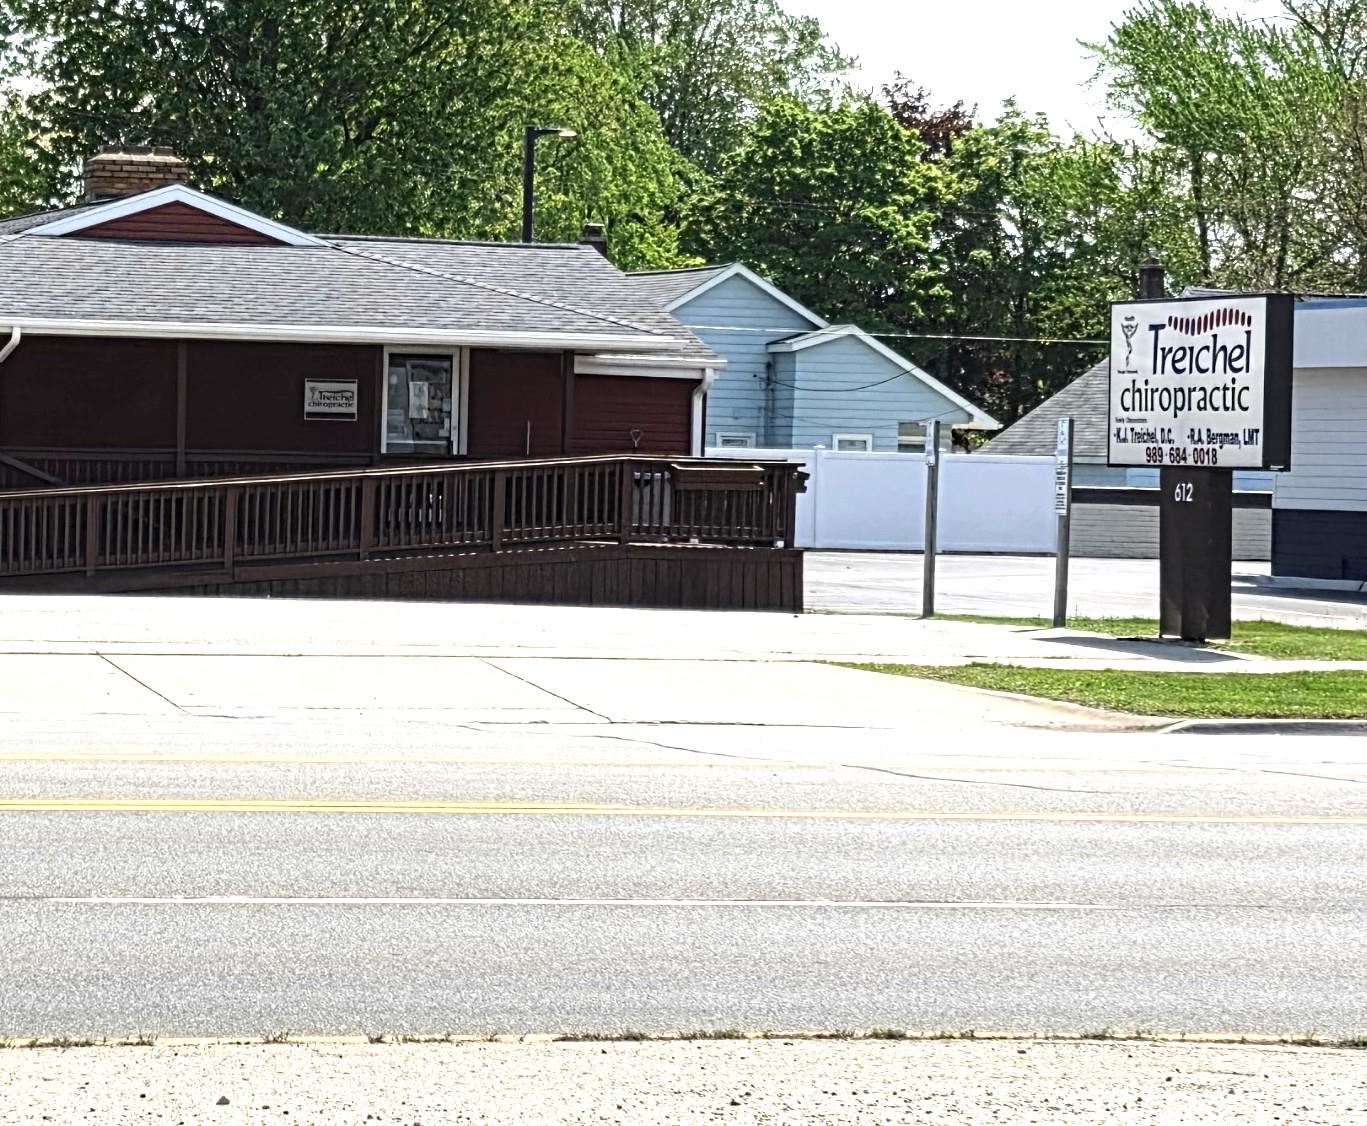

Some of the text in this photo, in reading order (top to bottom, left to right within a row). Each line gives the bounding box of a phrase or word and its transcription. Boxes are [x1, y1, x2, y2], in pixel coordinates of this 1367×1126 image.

[1148, 324, 1251, 374] Treichel
[1120, 377, 1249, 418] chiropractic
[1207, 428, 1241, 449] Bergman,
[1243, 428, 1259, 445] LMT
[1175, 483, 1193, 502] 612
